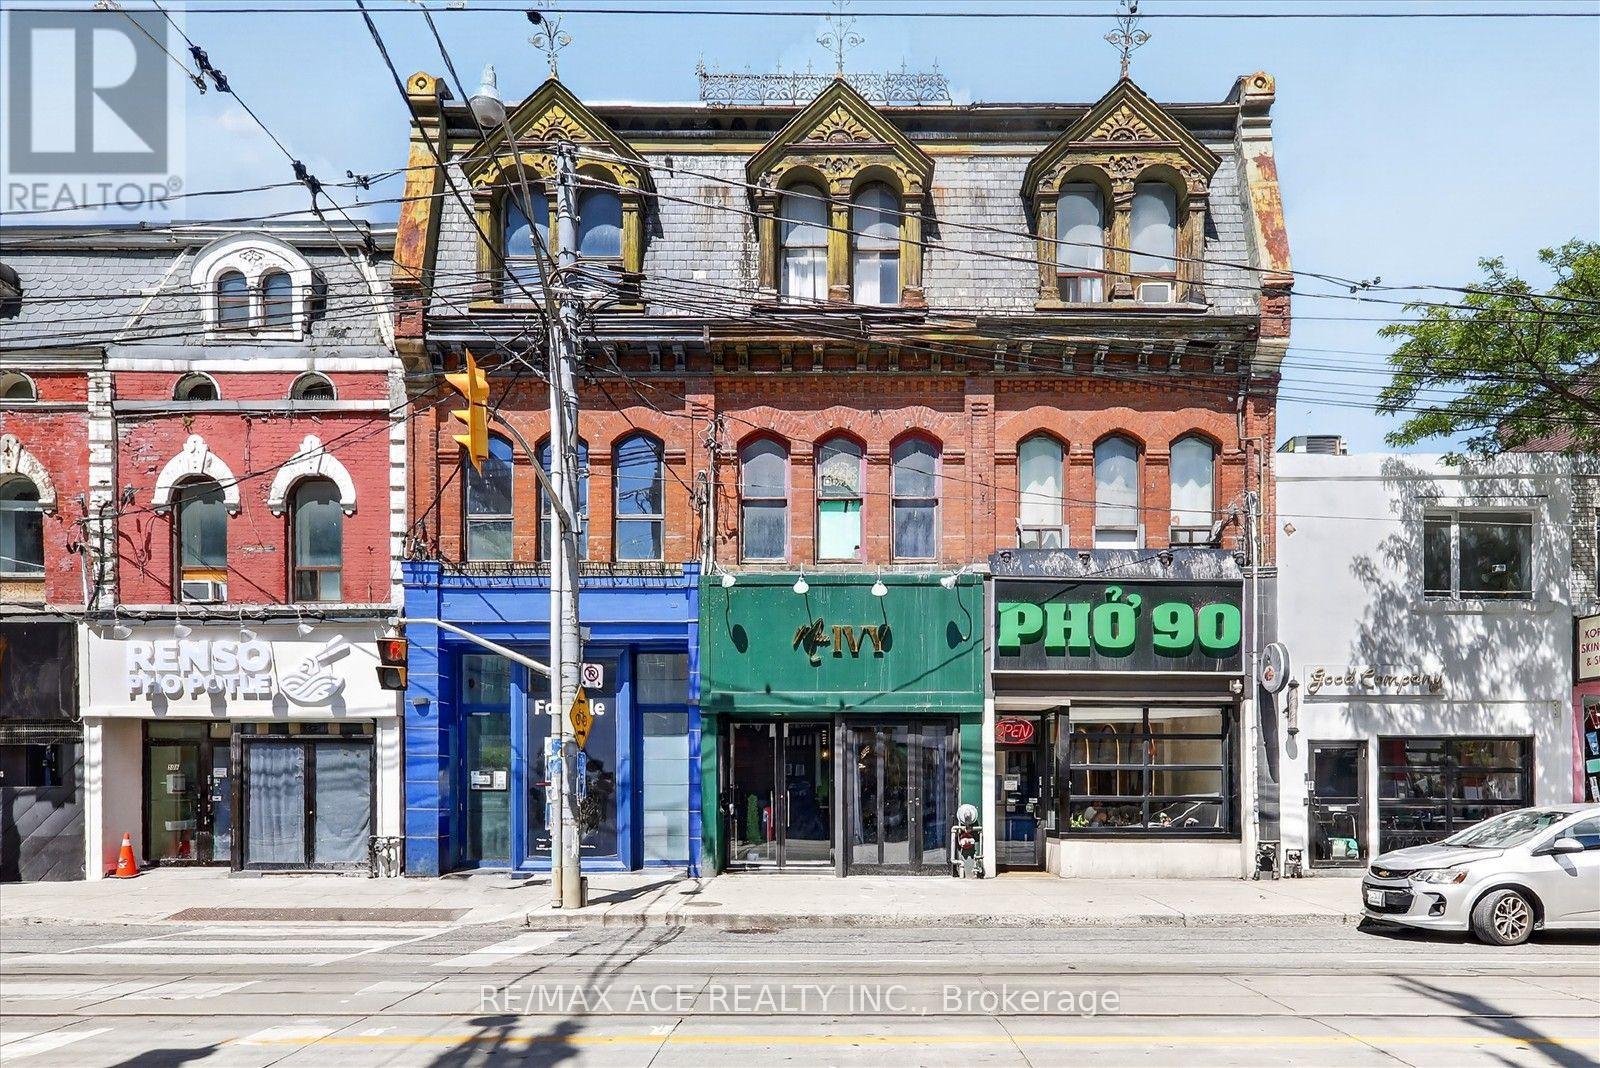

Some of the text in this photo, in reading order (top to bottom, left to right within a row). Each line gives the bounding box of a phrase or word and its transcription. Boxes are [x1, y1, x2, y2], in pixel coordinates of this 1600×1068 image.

[832, 624, 887, 653] IVY
[1152, 602, 1241, 650] 90
[127, 640, 272, 675] RENSO
[1594, 655, 1600, 665] S
[1307, 665, 1443, 696] Good Company
[995, 723, 1031, 739] OPEN
